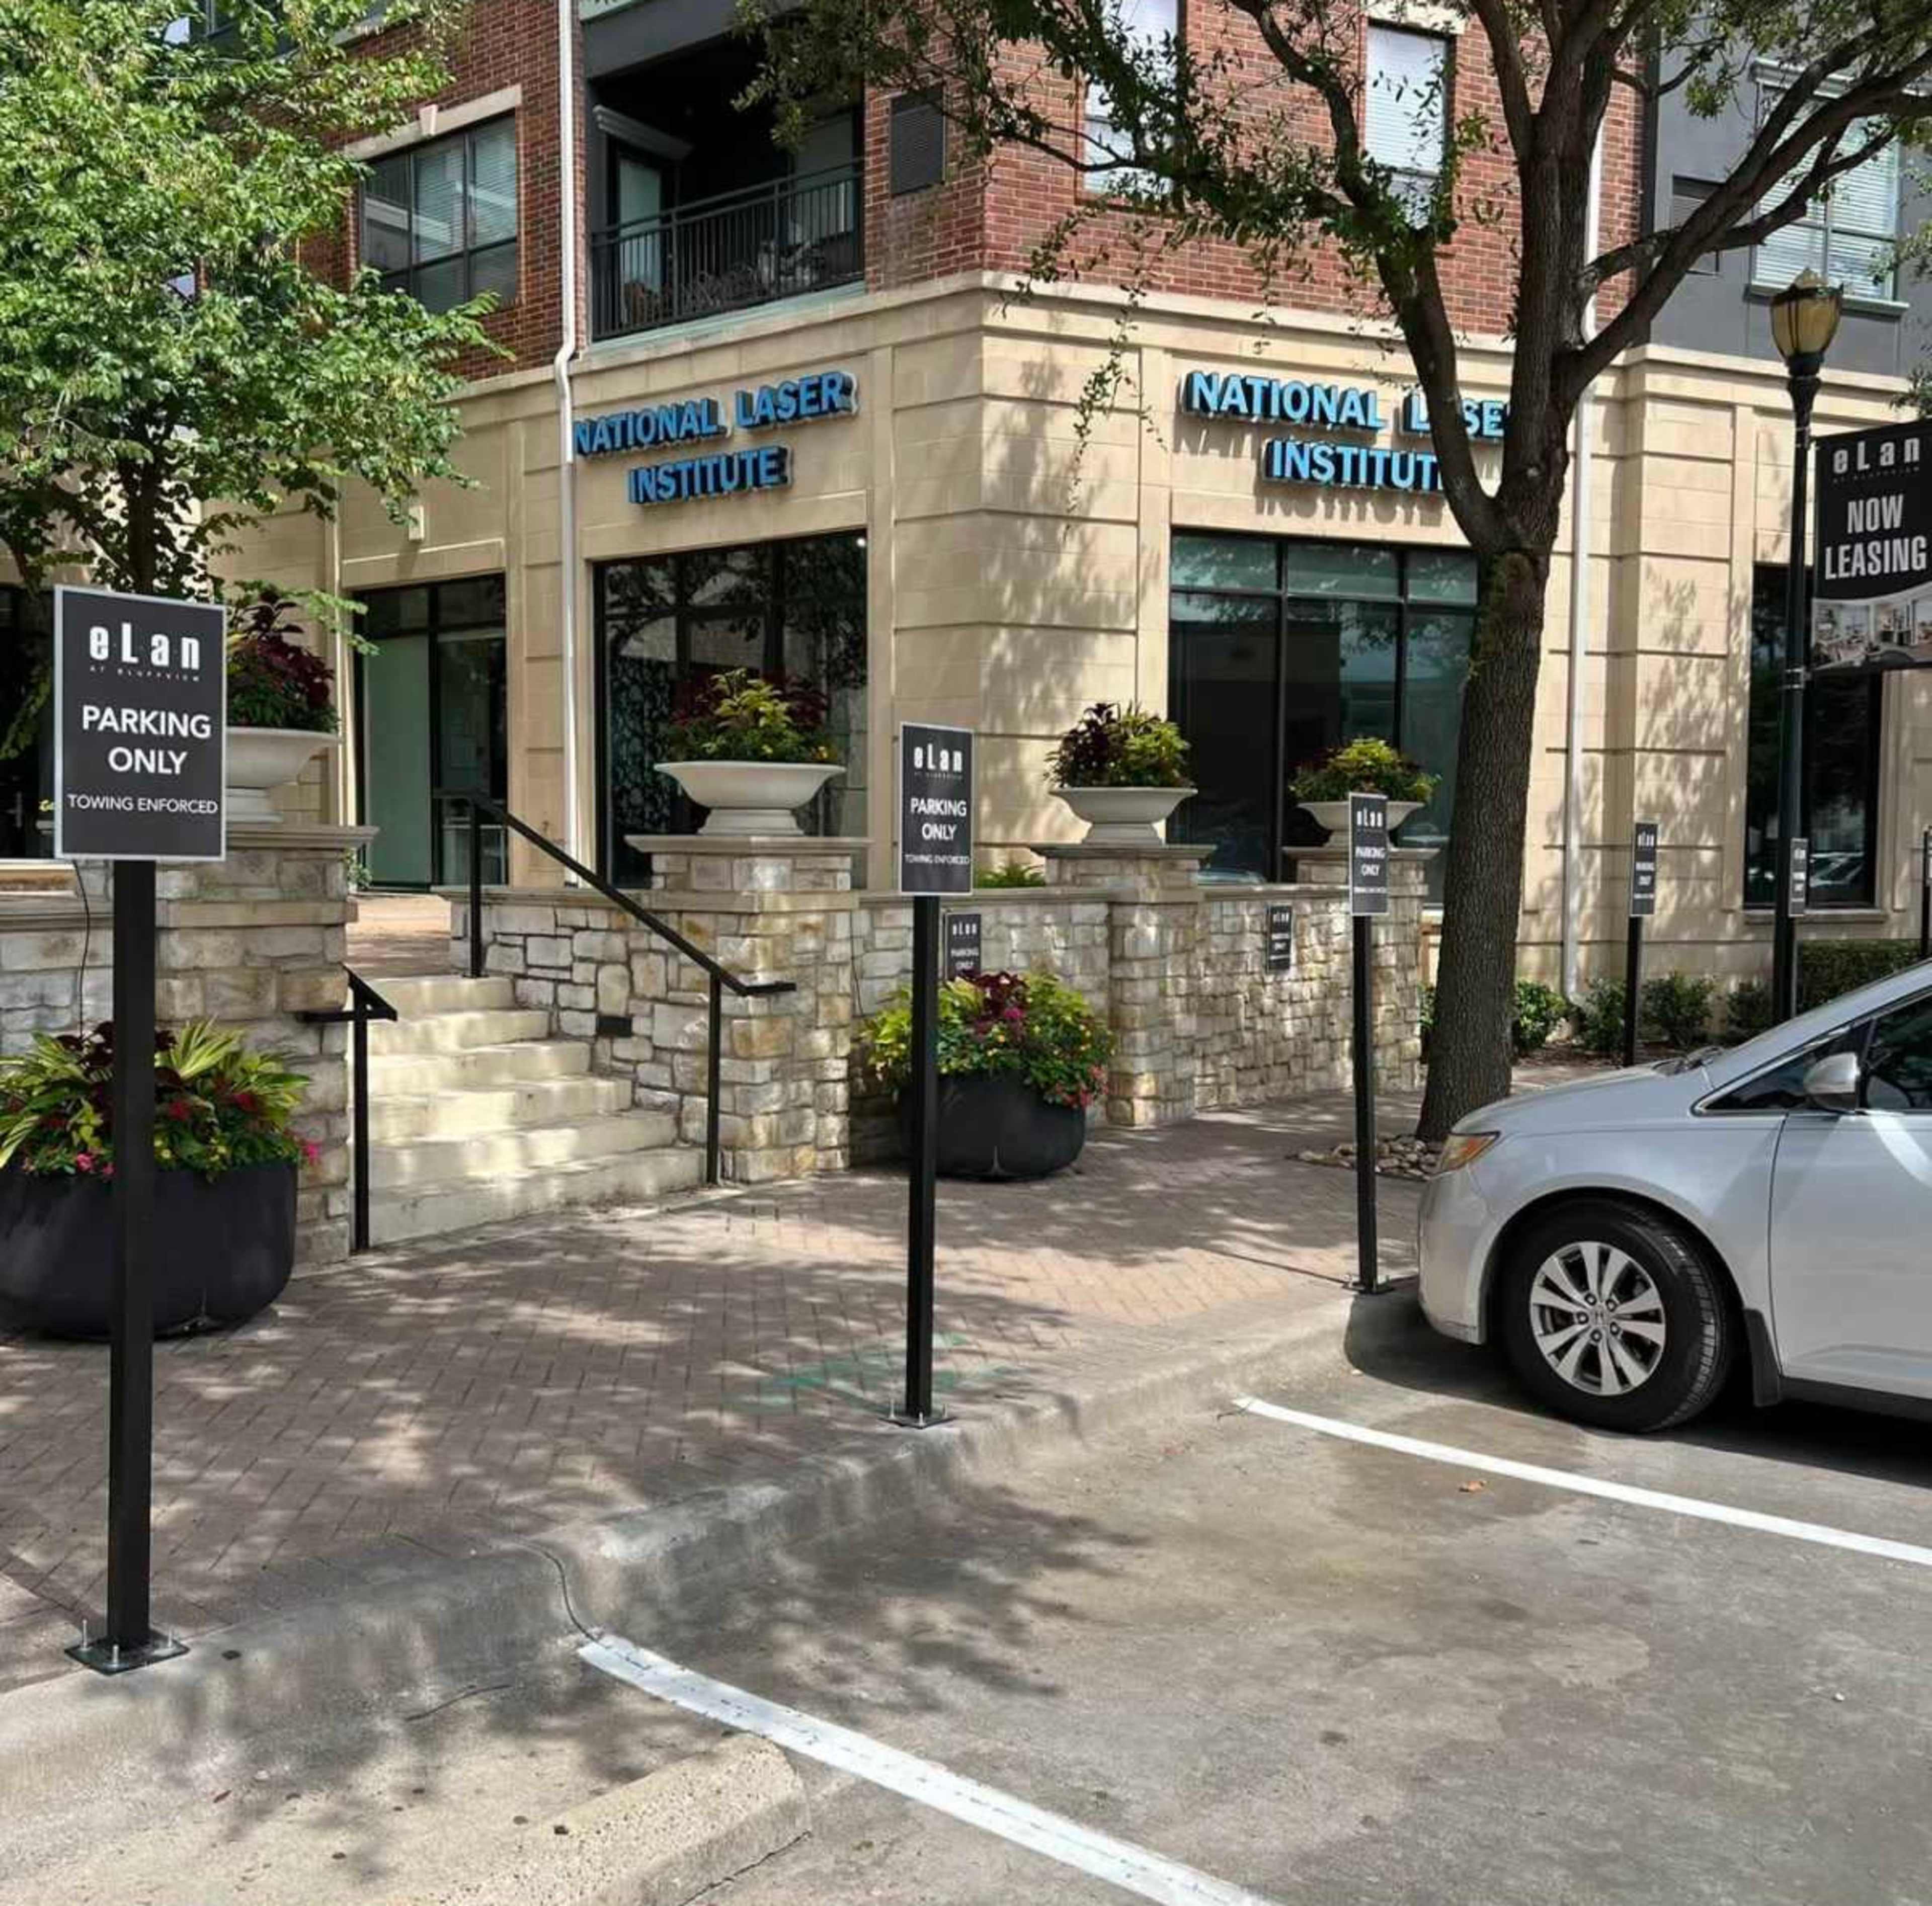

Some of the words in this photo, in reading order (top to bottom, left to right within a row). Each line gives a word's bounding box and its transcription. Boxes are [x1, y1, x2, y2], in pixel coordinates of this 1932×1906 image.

[574, 398, 722, 455] NATIONAL
[735, 371, 849, 428] LASER
[1189, 371, 1385, 429] NATIONAL
[1410, 389, 1510, 439] LSE
[629, 446, 784, 504] INSTITUTE
[1271, 438, 1444, 491] INSTITUT
[1833, 437, 1920, 475] eLan
[1847, 494, 1904, 534] NOW
[1825, 535, 1927, 580] LEASING
[90, 622, 199, 671] eLan
[83, 704, 211, 739] PARKING
[108, 746, 188, 775] ONLY
[67, 793, 135, 811] TOWING
[137, 797, 219, 814] ENFORCED
[910, 797, 967, 817] PARKING
[921, 822, 956, 841] ONLY
